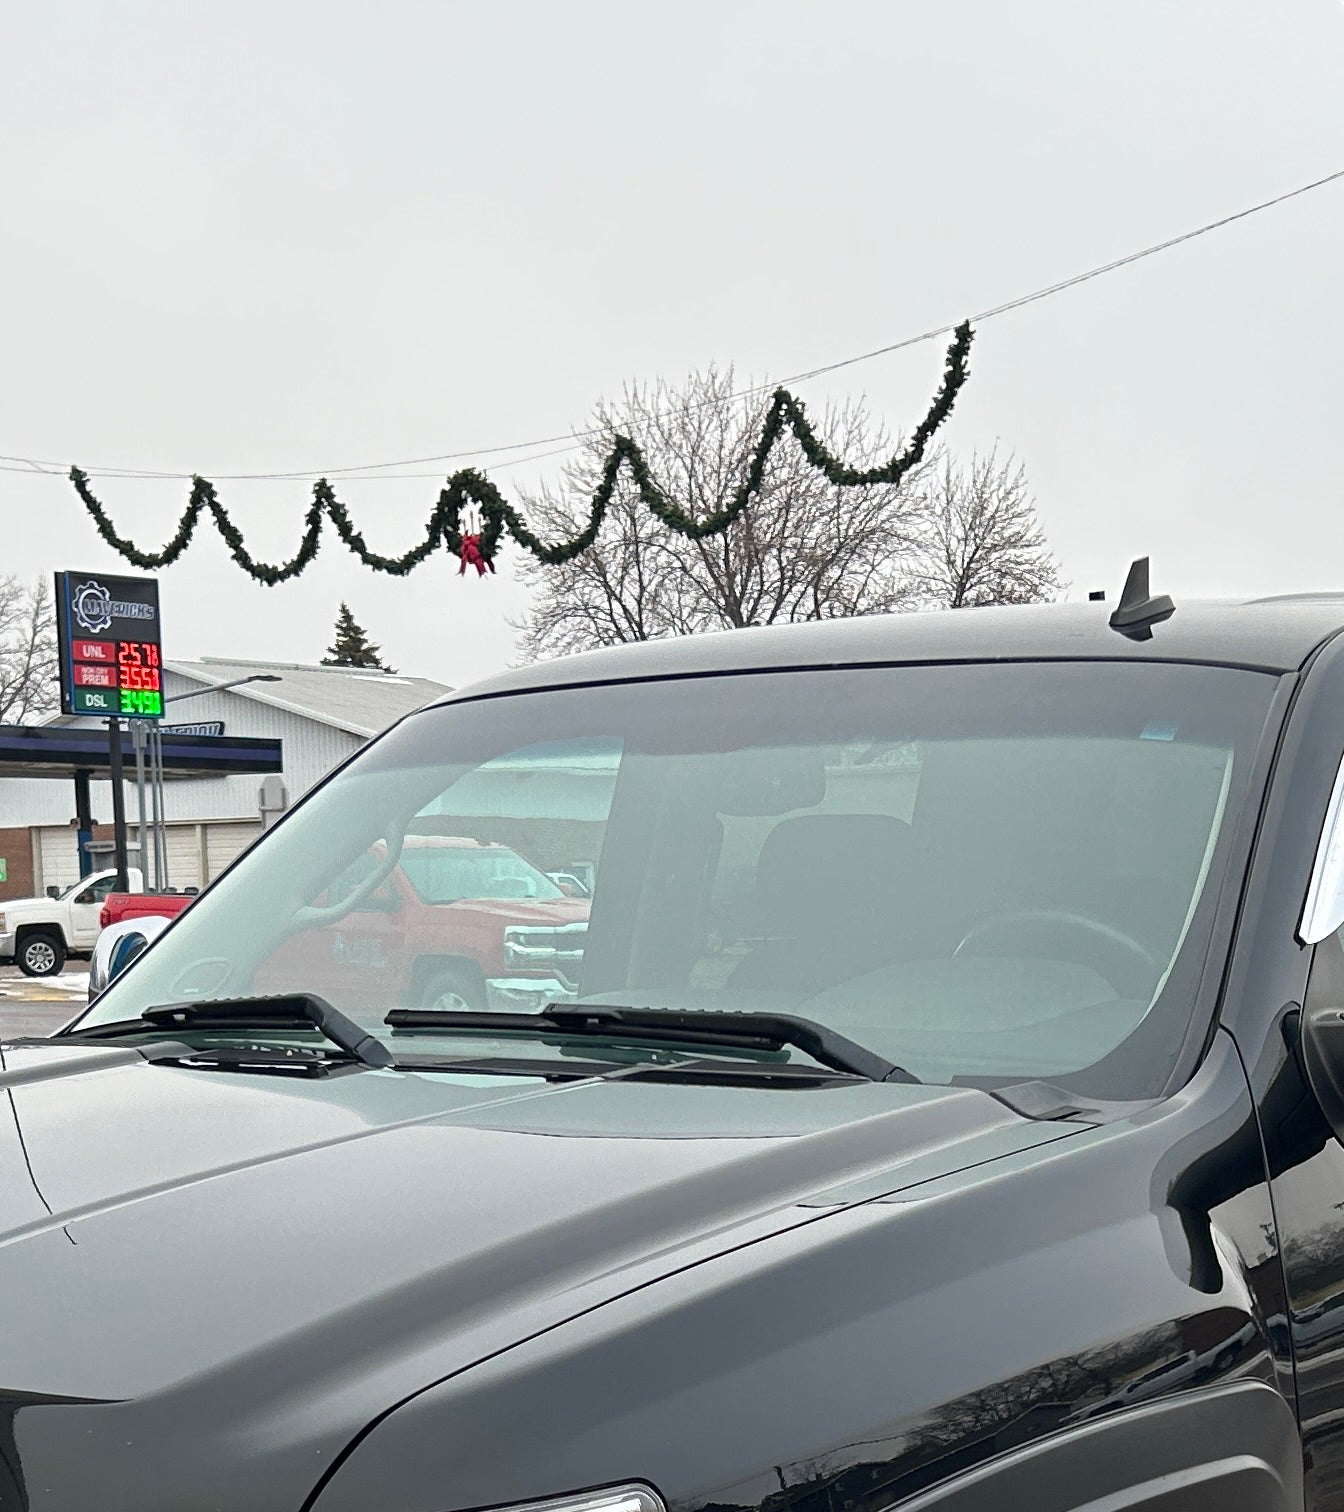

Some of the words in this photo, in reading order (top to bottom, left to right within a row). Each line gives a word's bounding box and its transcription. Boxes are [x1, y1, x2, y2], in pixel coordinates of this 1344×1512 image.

[82, 645, 106, 658] UNL
[82, 674, 110, 686] PREM
[85, 694, 108, 707] DSL
